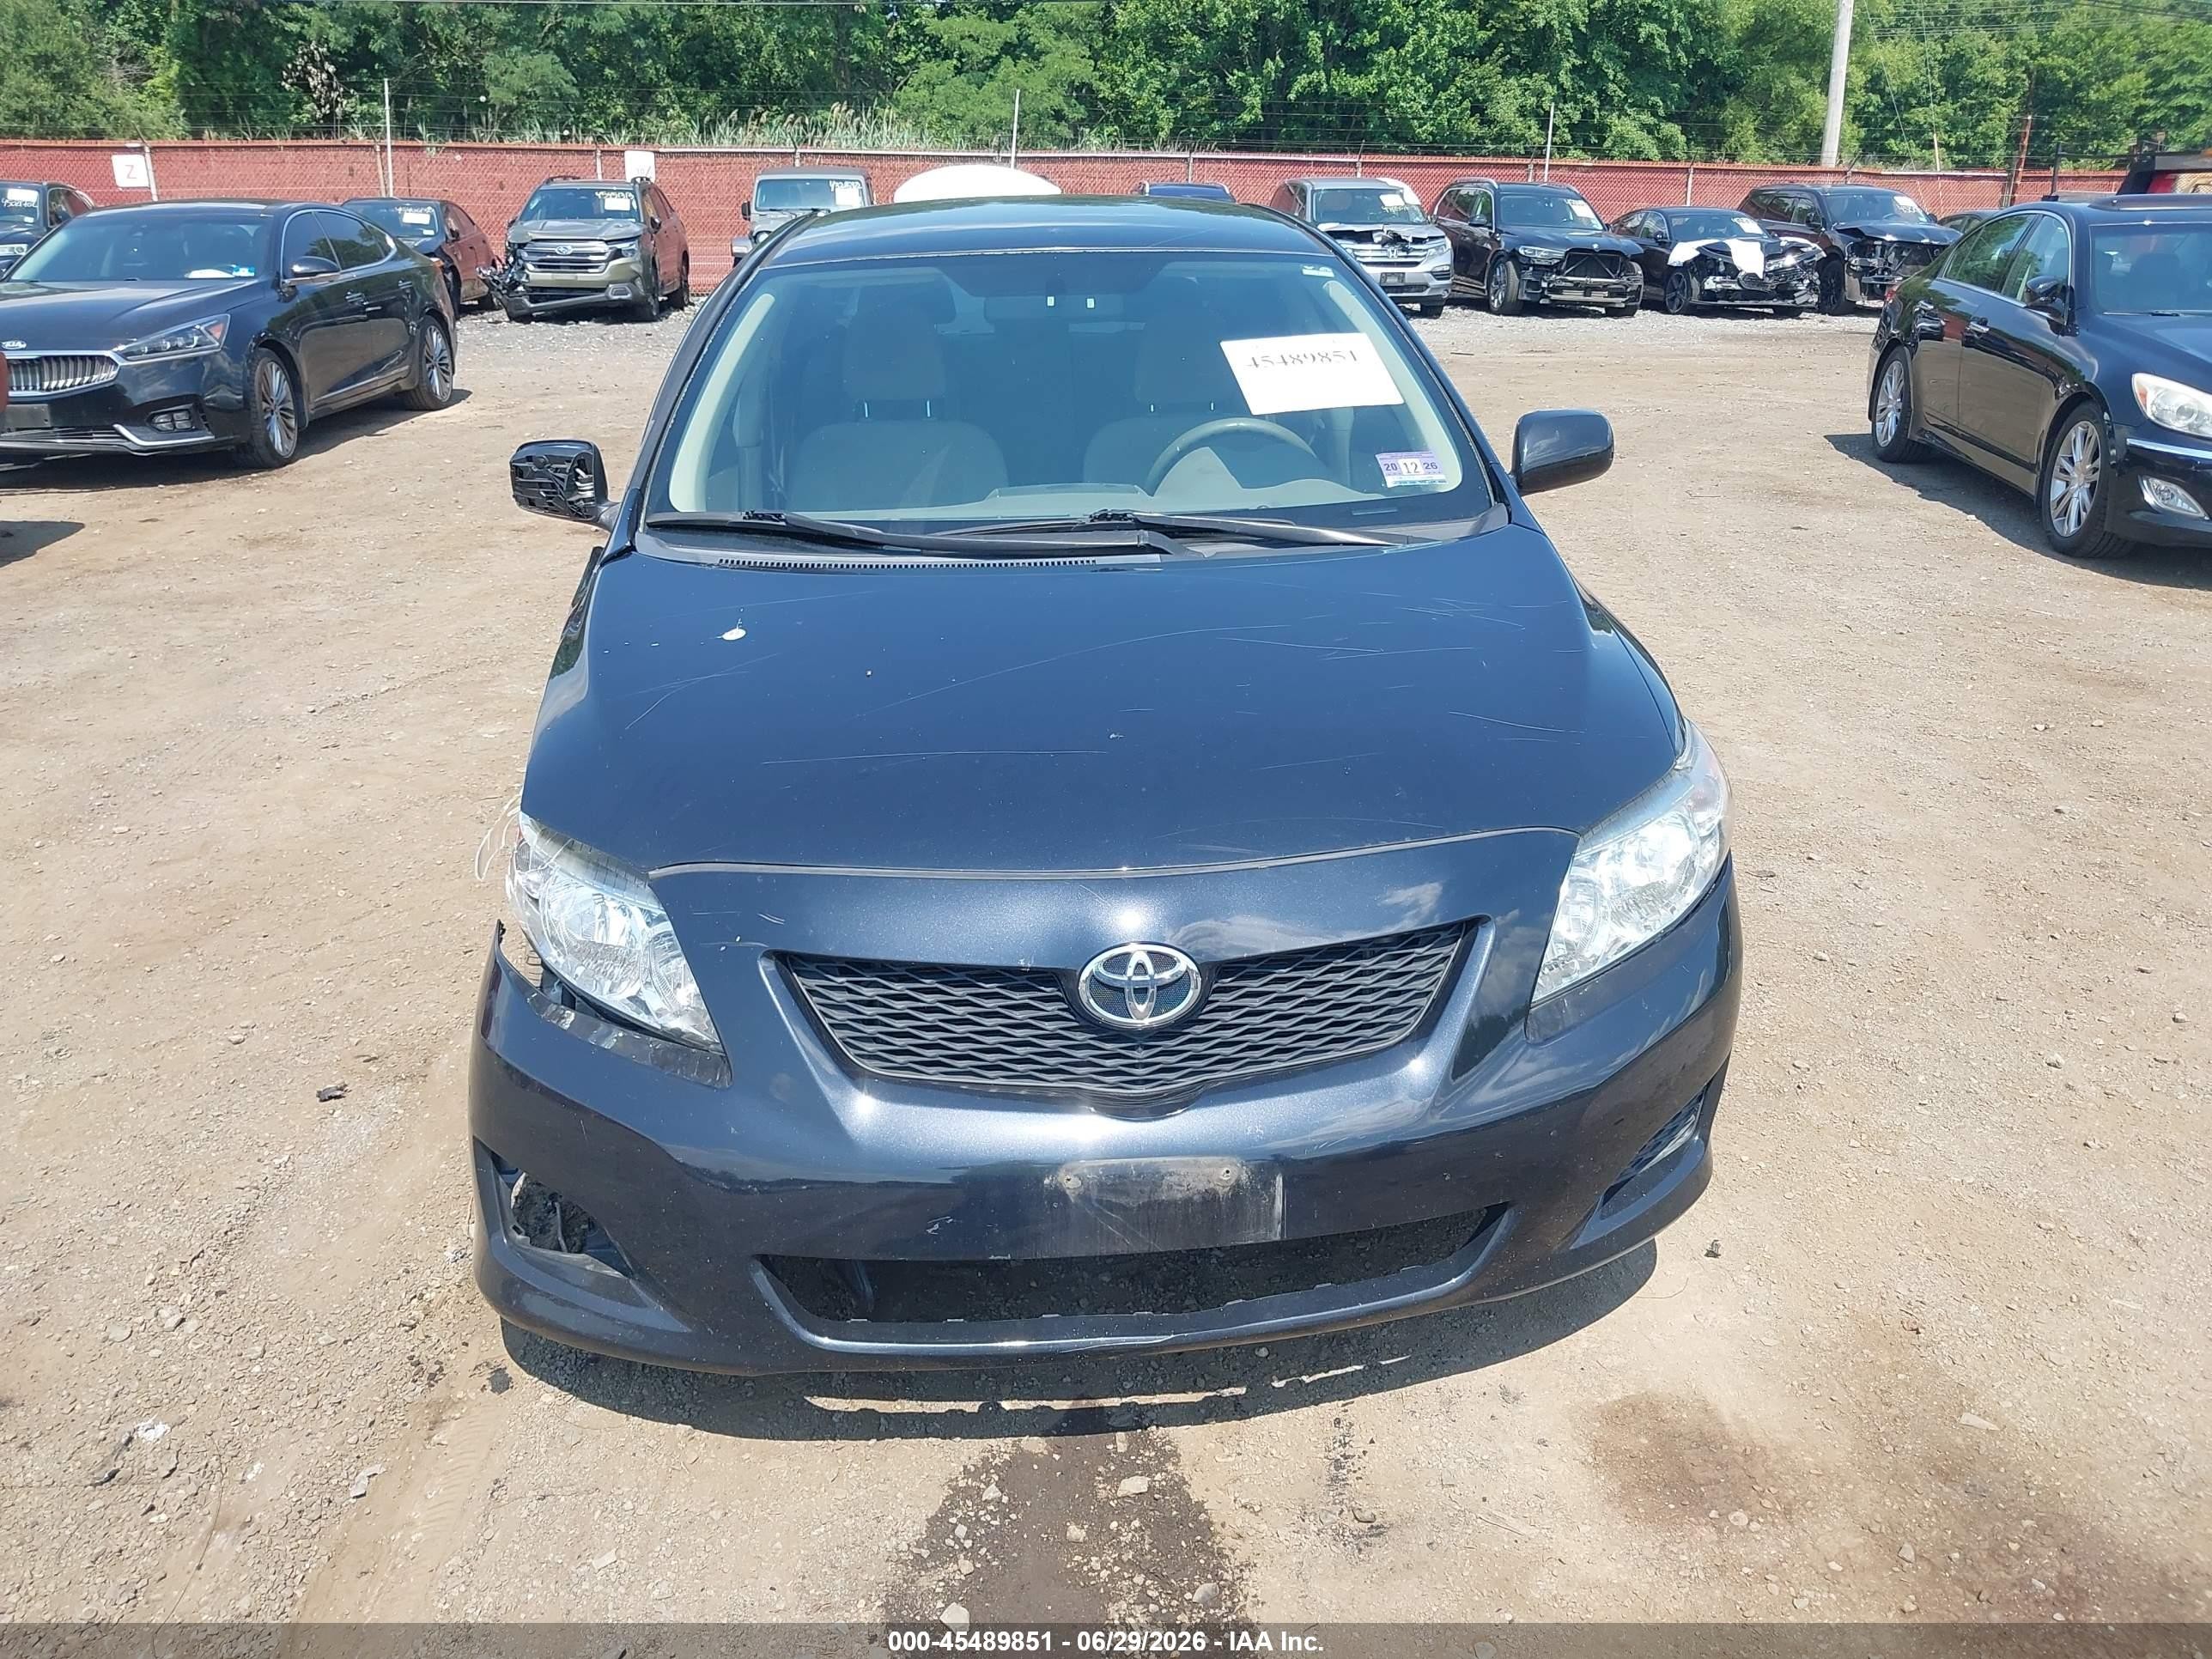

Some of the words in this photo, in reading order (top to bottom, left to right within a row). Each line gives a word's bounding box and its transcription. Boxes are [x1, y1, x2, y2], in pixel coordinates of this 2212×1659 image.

[125, 164, 137, 179] Z
[1246, 349, 1358, 368] 45489851
[1383, 463, 1398, 471] 20
[1403, 461, 1422, 474] 12
